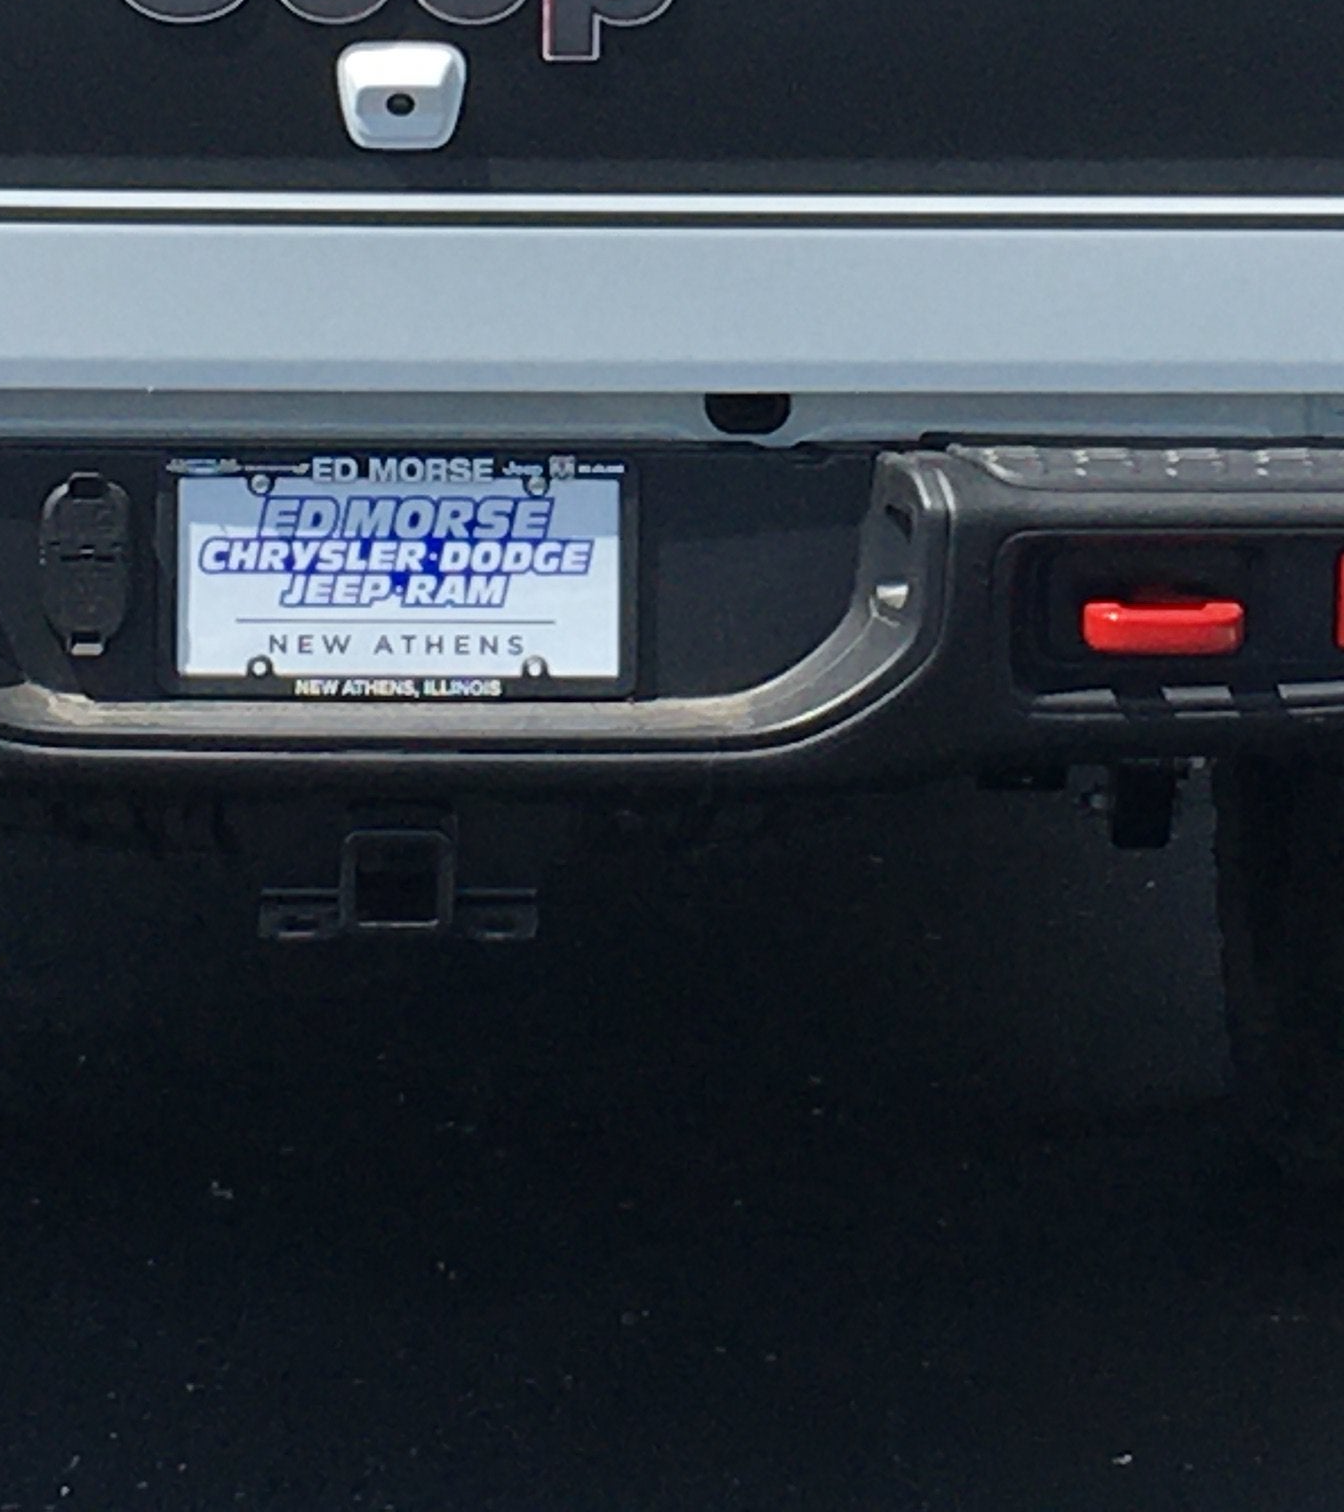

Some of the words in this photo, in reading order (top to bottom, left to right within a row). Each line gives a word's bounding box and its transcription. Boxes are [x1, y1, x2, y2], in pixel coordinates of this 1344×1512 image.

[312, 457, 358, 483] ED
[369, 457, 494, 483] MORSE
[259, 496, 340, 538] ED
[344, 497, 554, 539] MORSE
[199, 537, 430, 574] CHRYSLER
[435, 540, 594, 575] DODGE
[280, 573, 394, 608] JEEP
[399, 575, 511, 608] RAM
[269, 634, 351, 655] NEW
[373, 635, 524, 656] ATHENS
[294, 679, 338, 696] NEW
[341, 679, 419, 698] ATHENS,
[422, 679, 502, 697] ILLINOIS
